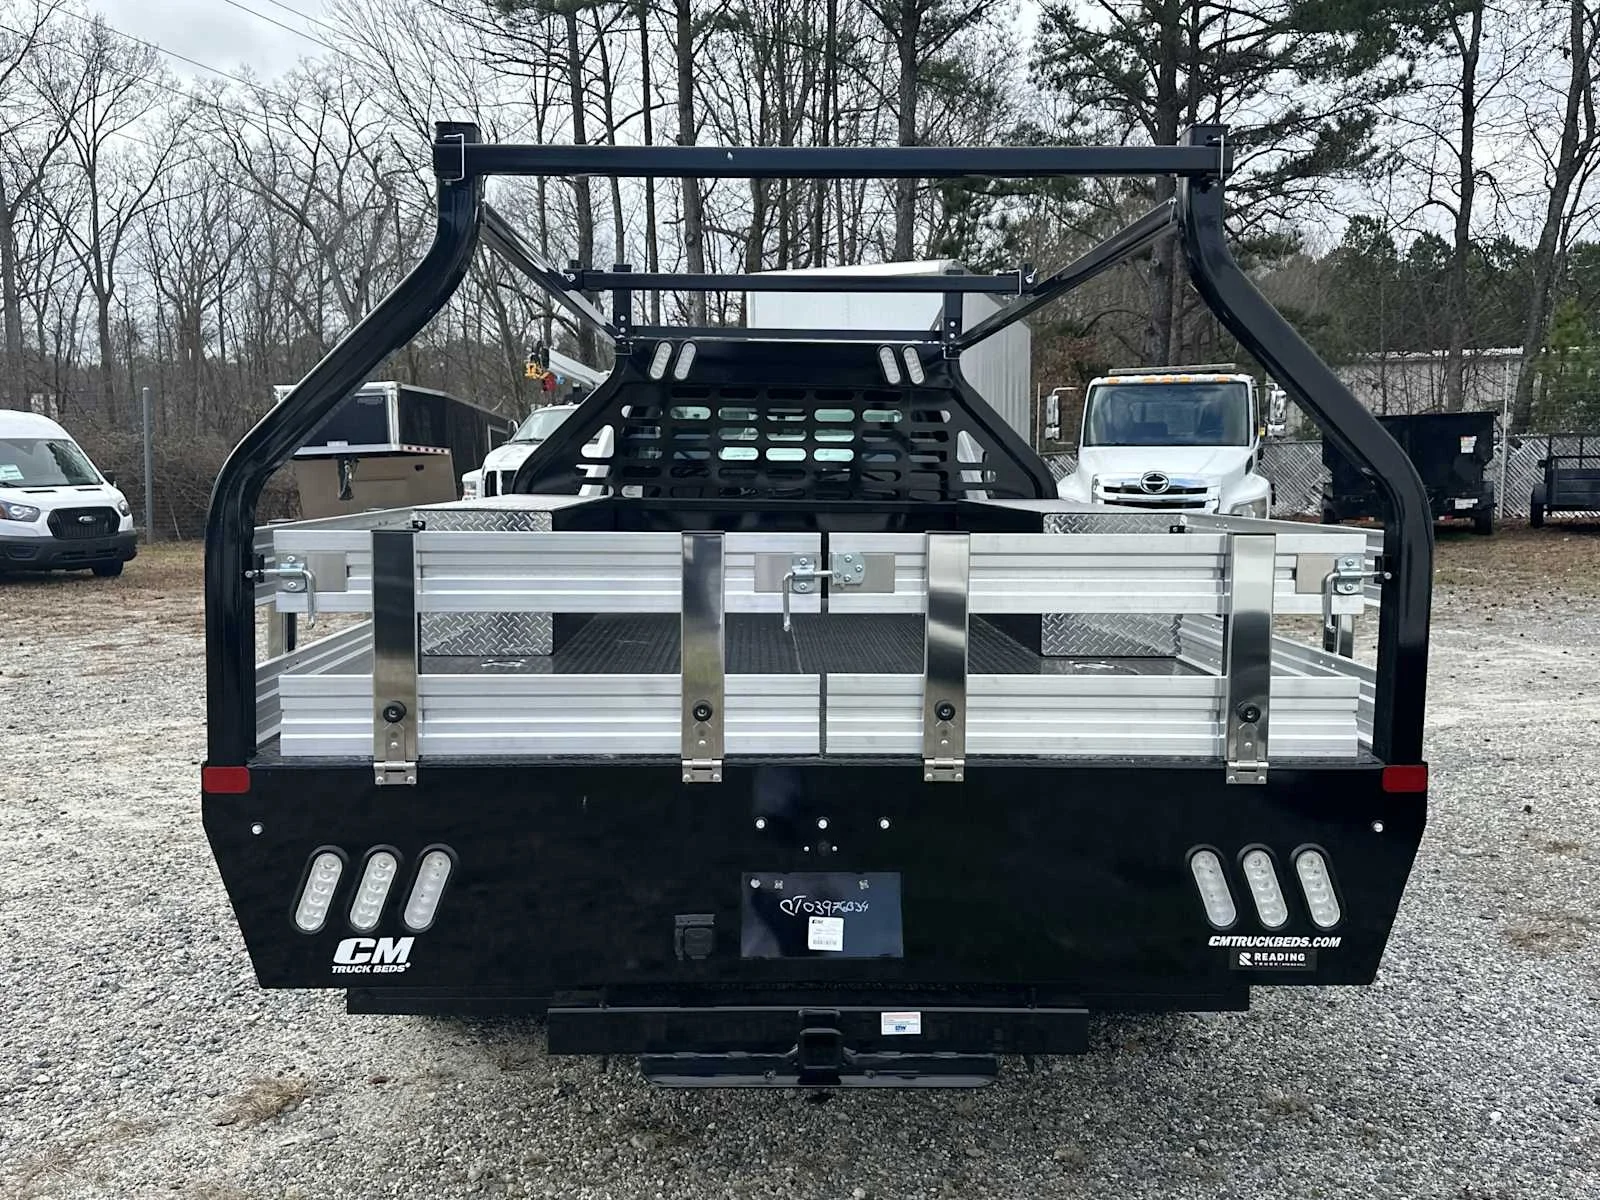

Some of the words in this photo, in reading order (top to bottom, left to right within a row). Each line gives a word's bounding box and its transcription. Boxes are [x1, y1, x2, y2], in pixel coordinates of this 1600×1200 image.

[1208, 935, 1342, 948] CMTRUCKBEDS.COM
[333, 937, 415, 964] CM
[1254, 952, 1306, 962] READING
[332, 965, 371, 974] TRUCK
